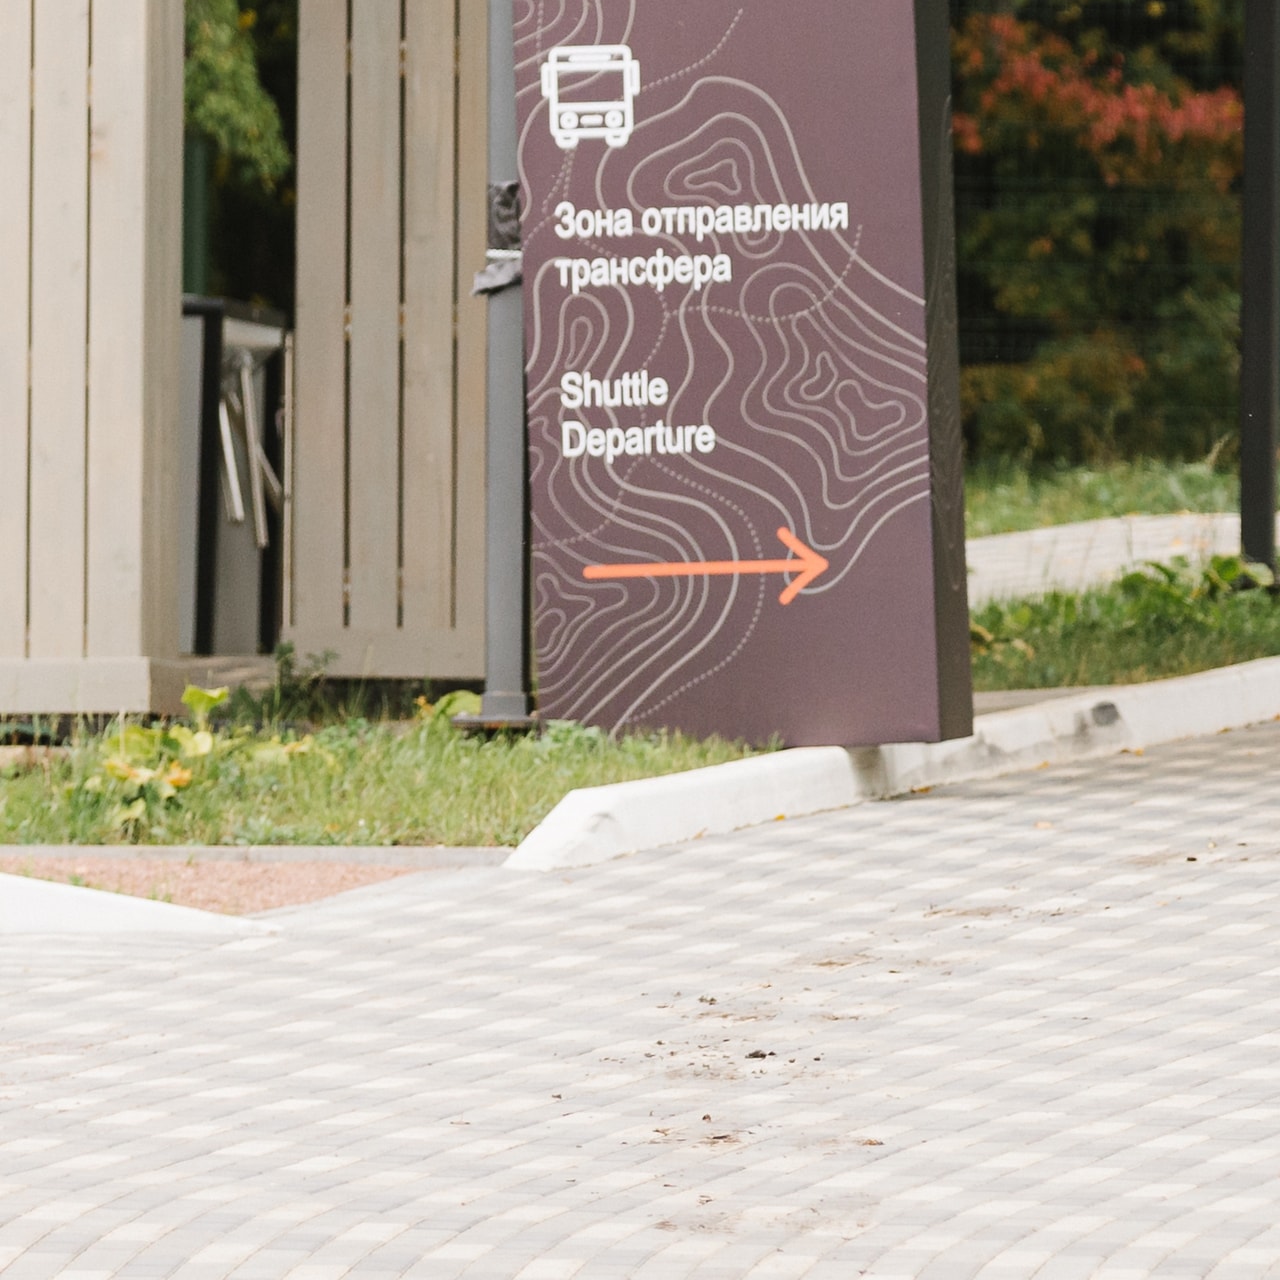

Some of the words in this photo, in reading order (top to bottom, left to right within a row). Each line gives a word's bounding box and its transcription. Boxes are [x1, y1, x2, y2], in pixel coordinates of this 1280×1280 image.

[554, 201, 633, 239] Зона
[641, 200, 849, 241] отправления
[554, 249, 732, 294] трансфера
[560, 370, 668, 410] Shuttle
[560, 419, 716, 465] Departure
